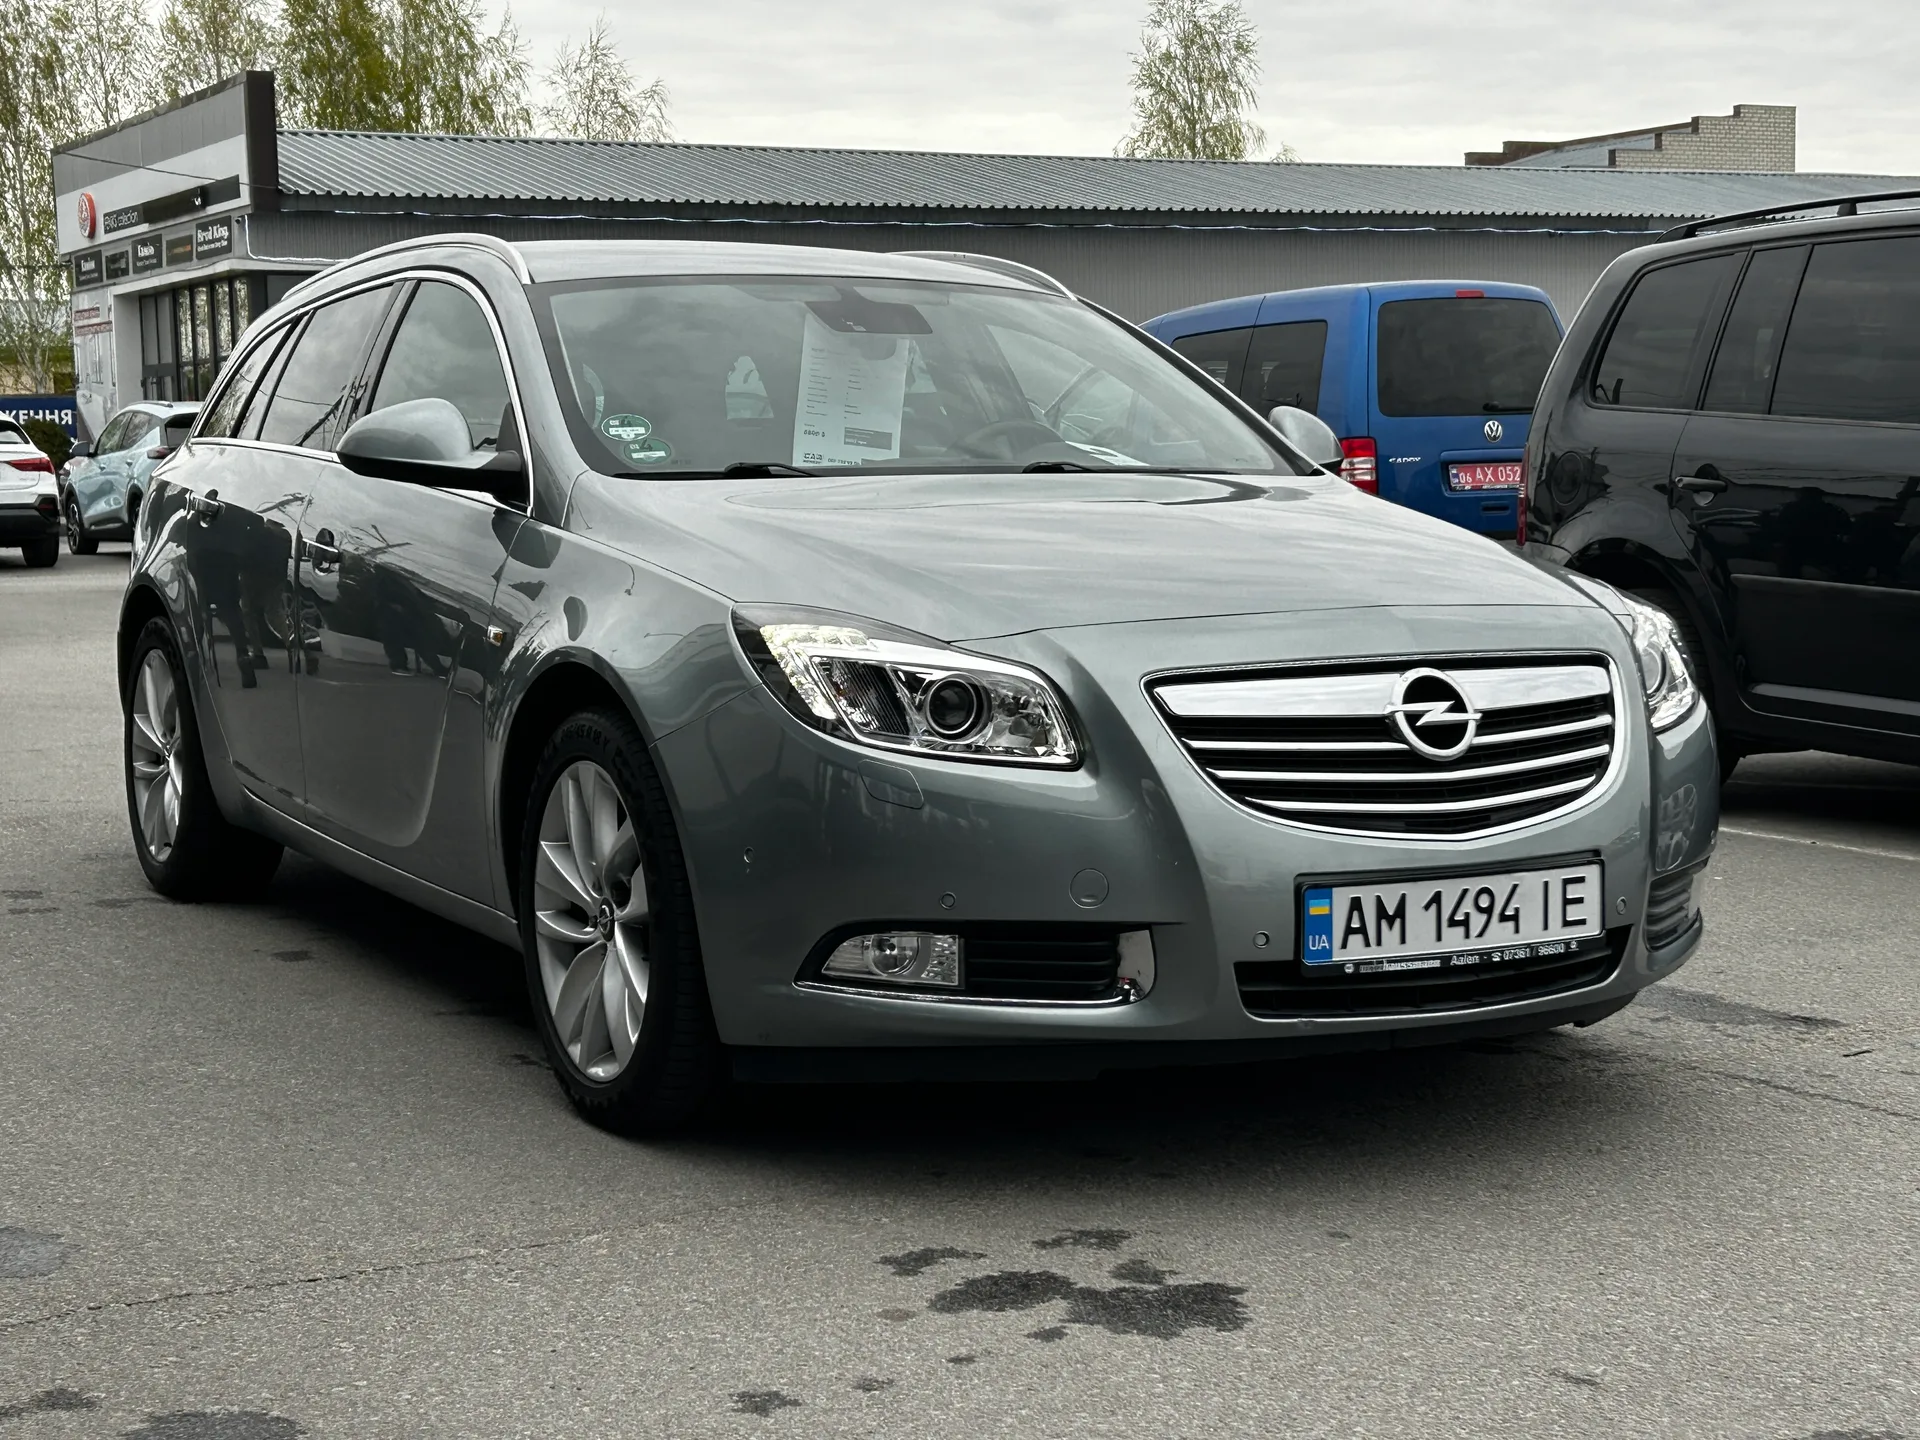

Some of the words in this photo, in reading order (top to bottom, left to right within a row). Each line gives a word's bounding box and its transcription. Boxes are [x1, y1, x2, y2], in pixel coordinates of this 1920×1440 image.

[1388, 456, 1421, 464] CADDY
[1476, 466, 1494, 483] AX
[1340, 892, 1407, 950] AM
[1421, 883, 1521, 943] 1494
[1542, 875, 1588, 931] IE
[1308, 935, 1330, 951] UA
